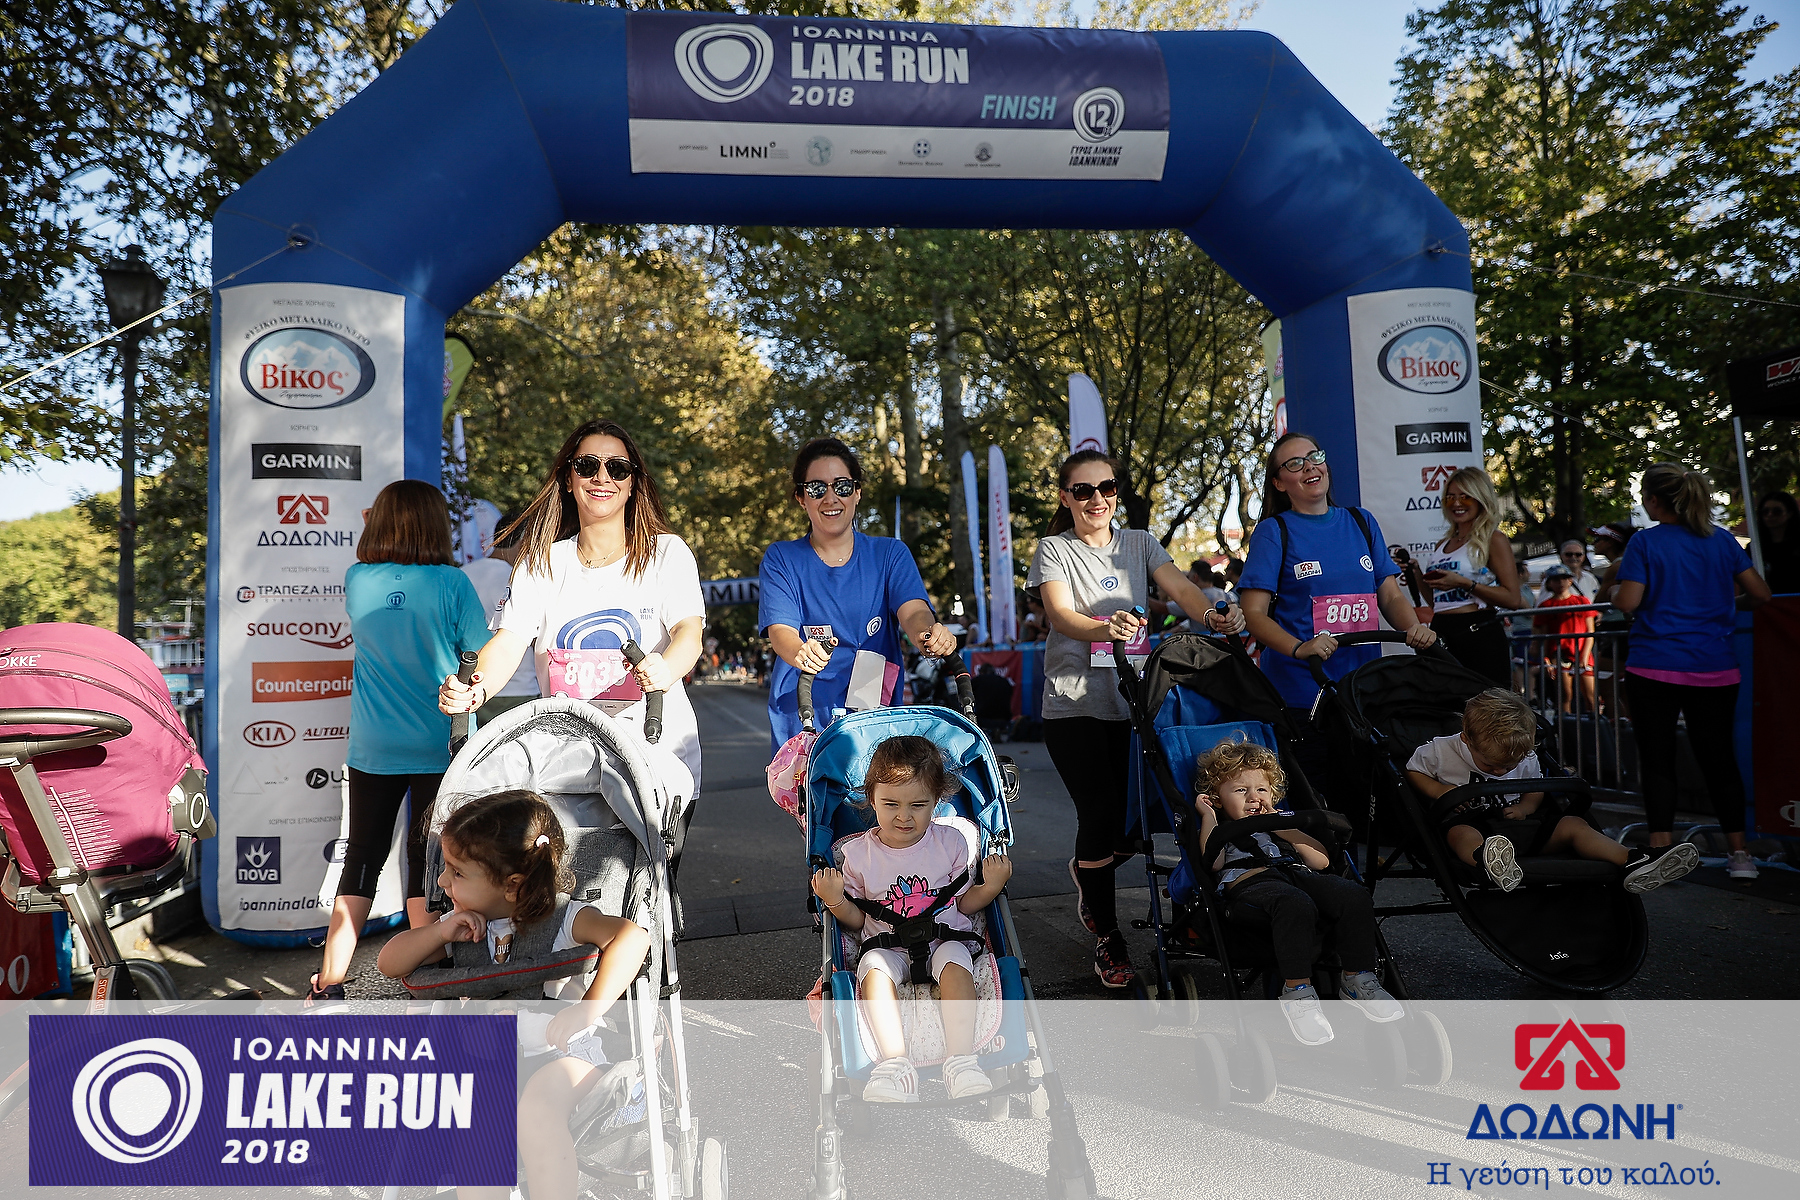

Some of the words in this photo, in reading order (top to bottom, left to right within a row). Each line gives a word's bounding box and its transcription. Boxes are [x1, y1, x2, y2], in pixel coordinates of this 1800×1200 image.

[793, 25, 938, 43] IOANNINA
[791, 42, 884, 82] LAKE
[891, 46, 970, 84] RUN
[788, 86, 855, 108] 2018
[980, 95, 1057, 120] FINISH
[1088, 104, 1111, 128] 12
[720, 145, 768, 159] LIMNI
[1400, 357, 1461, 381] Βίκος
[261, 363, 344, 396] Βίκος
[1406, 431, 1468, 446] GARMIN
[261, 453, 351, 470] GARMIN
[257, 530, 353, 547] ΔΩΔΩΝΗ
[258, 584, 319, 595] ΤΡΑΠΕΖΑ
[1326, 604, 1369, 624] 8053
[247, 621, 343, 639] saucony
[253, 727, 286, 741] KIA
[238, 868, 279, 882] nova
[95, 979, 107, 1009] STOKKE
